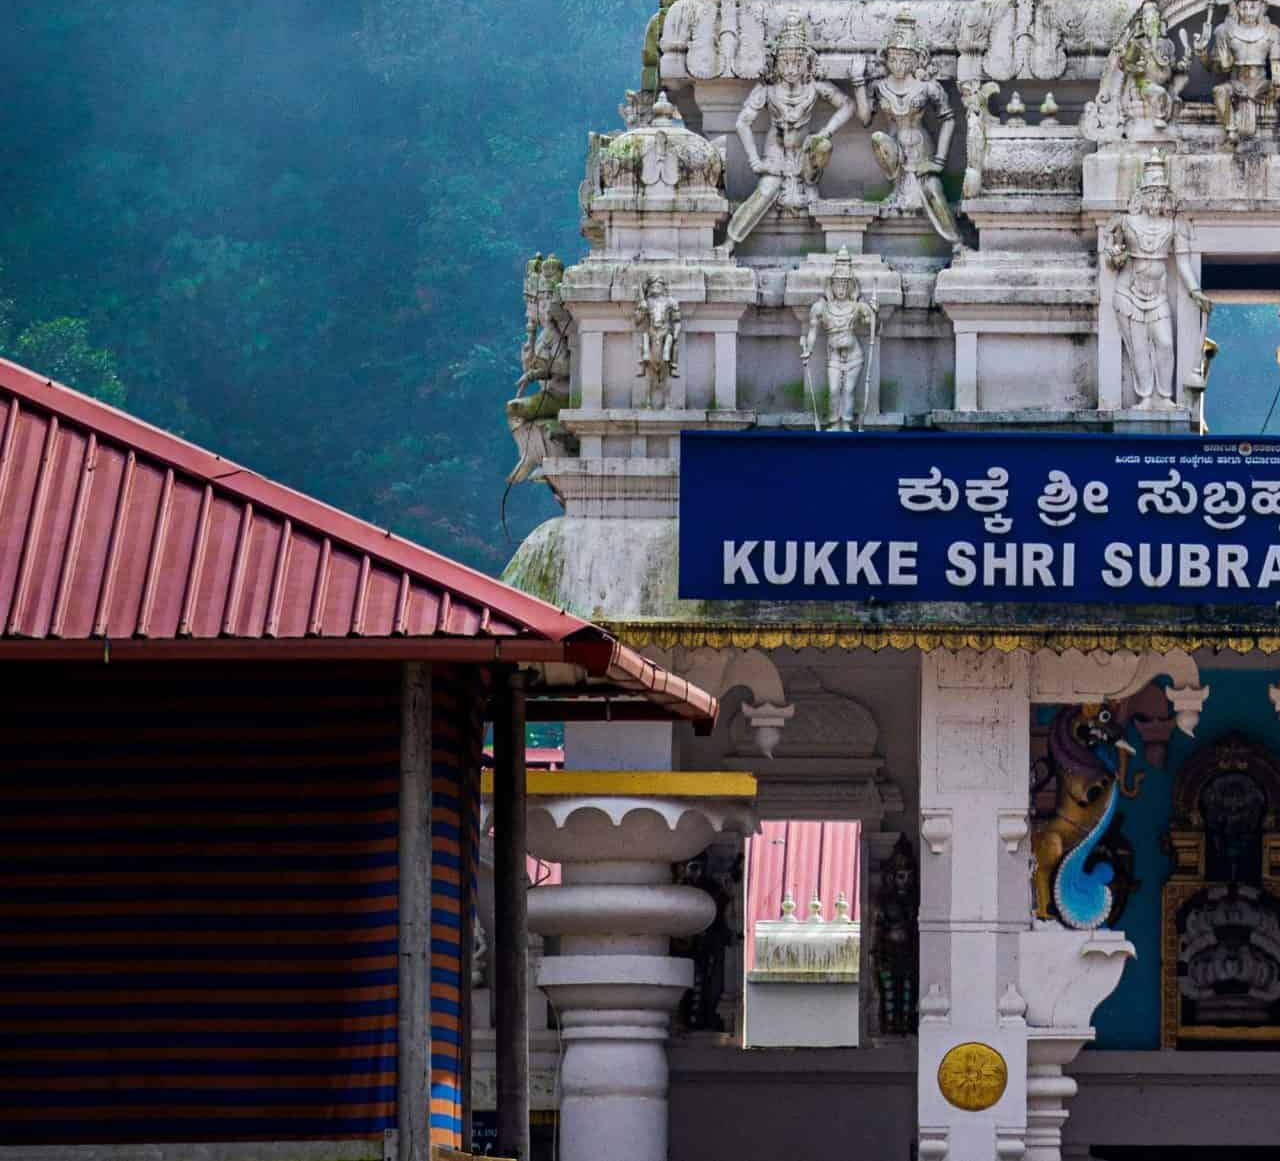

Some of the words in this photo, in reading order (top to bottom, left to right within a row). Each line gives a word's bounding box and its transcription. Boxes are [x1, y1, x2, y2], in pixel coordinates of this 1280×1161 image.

[897, 466, 1014, 534] ಕುಕ್ಕೆ
[1037, 469, 1109, 527] ಶ್ರೀ
[723, 540, 919, 586] KUKKE
[945, 541, 1076, 588] SHRI
